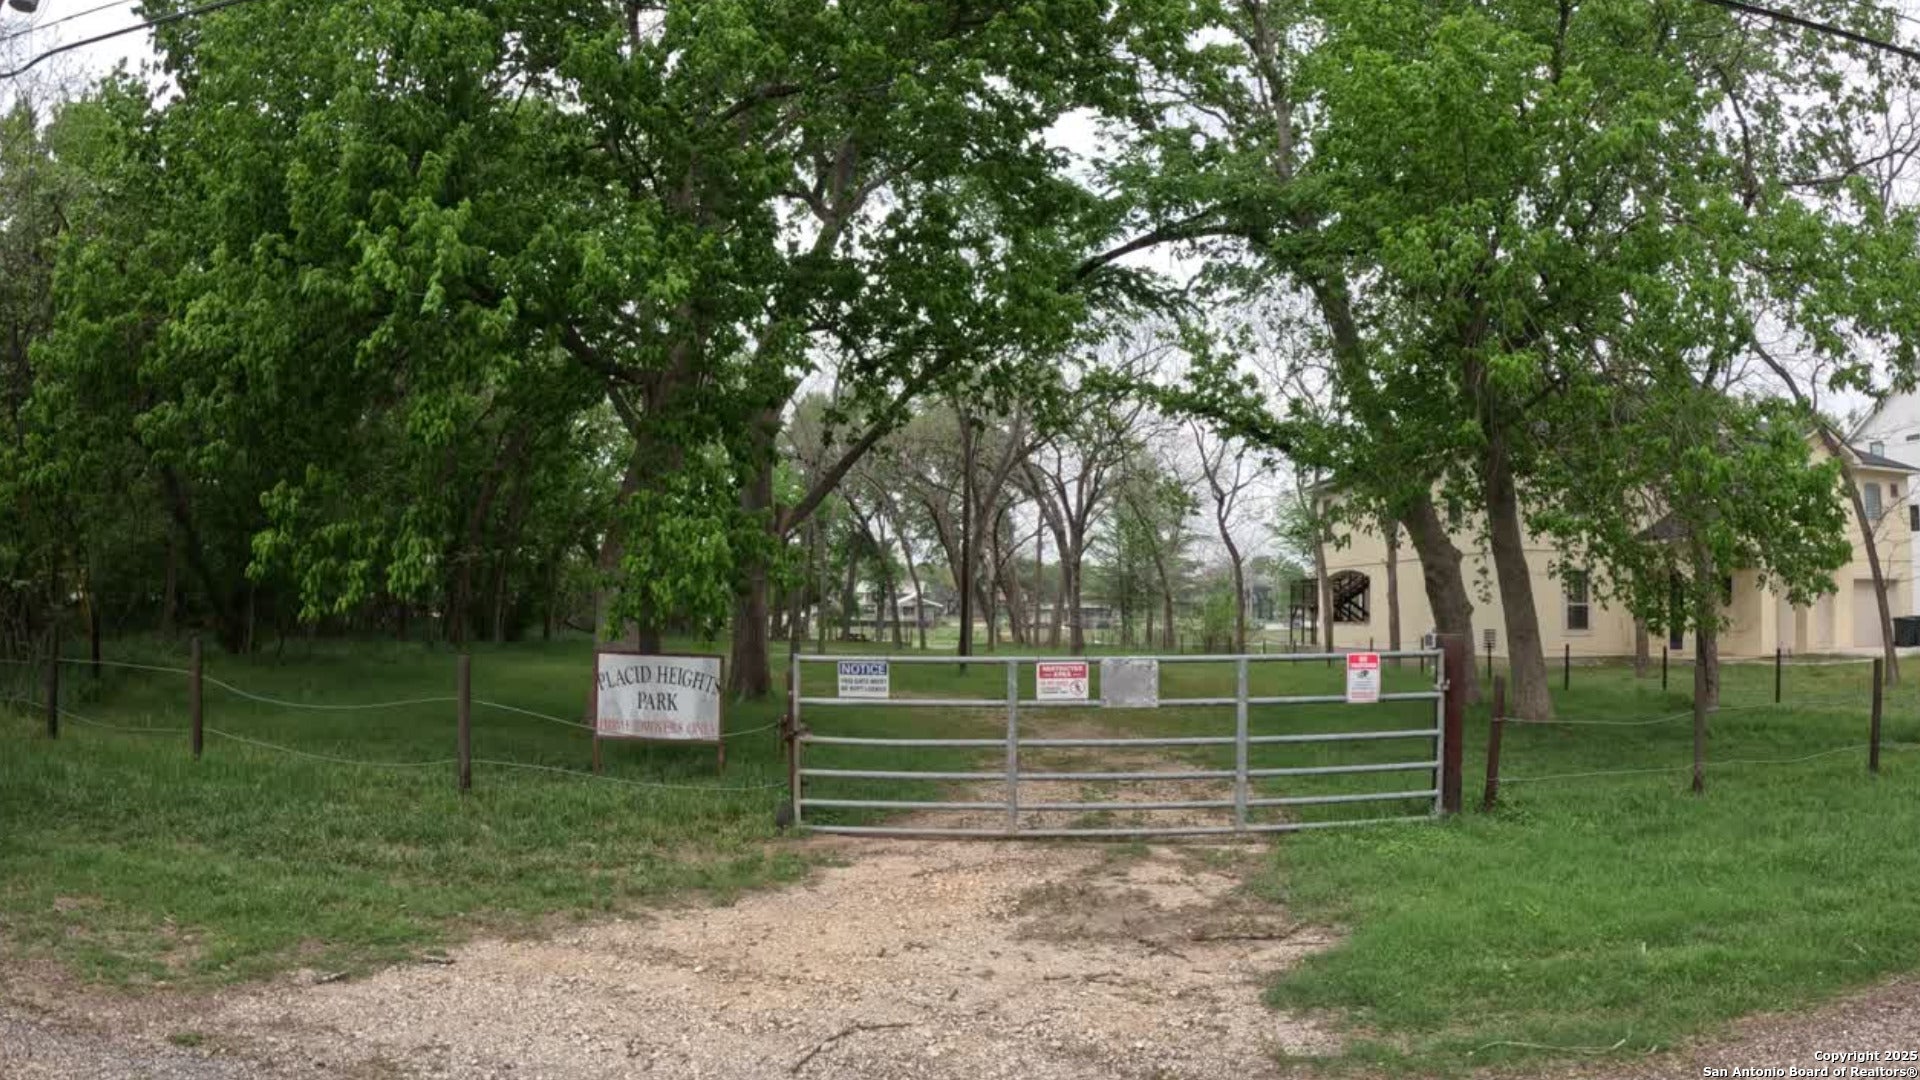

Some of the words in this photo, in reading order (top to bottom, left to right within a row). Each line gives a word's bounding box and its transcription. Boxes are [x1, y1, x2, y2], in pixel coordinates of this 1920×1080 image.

[598, 666, 651, 690] PLACID
[841, 663, 887, 674] NOTICE
[637, 691, 679, 711] PARK
